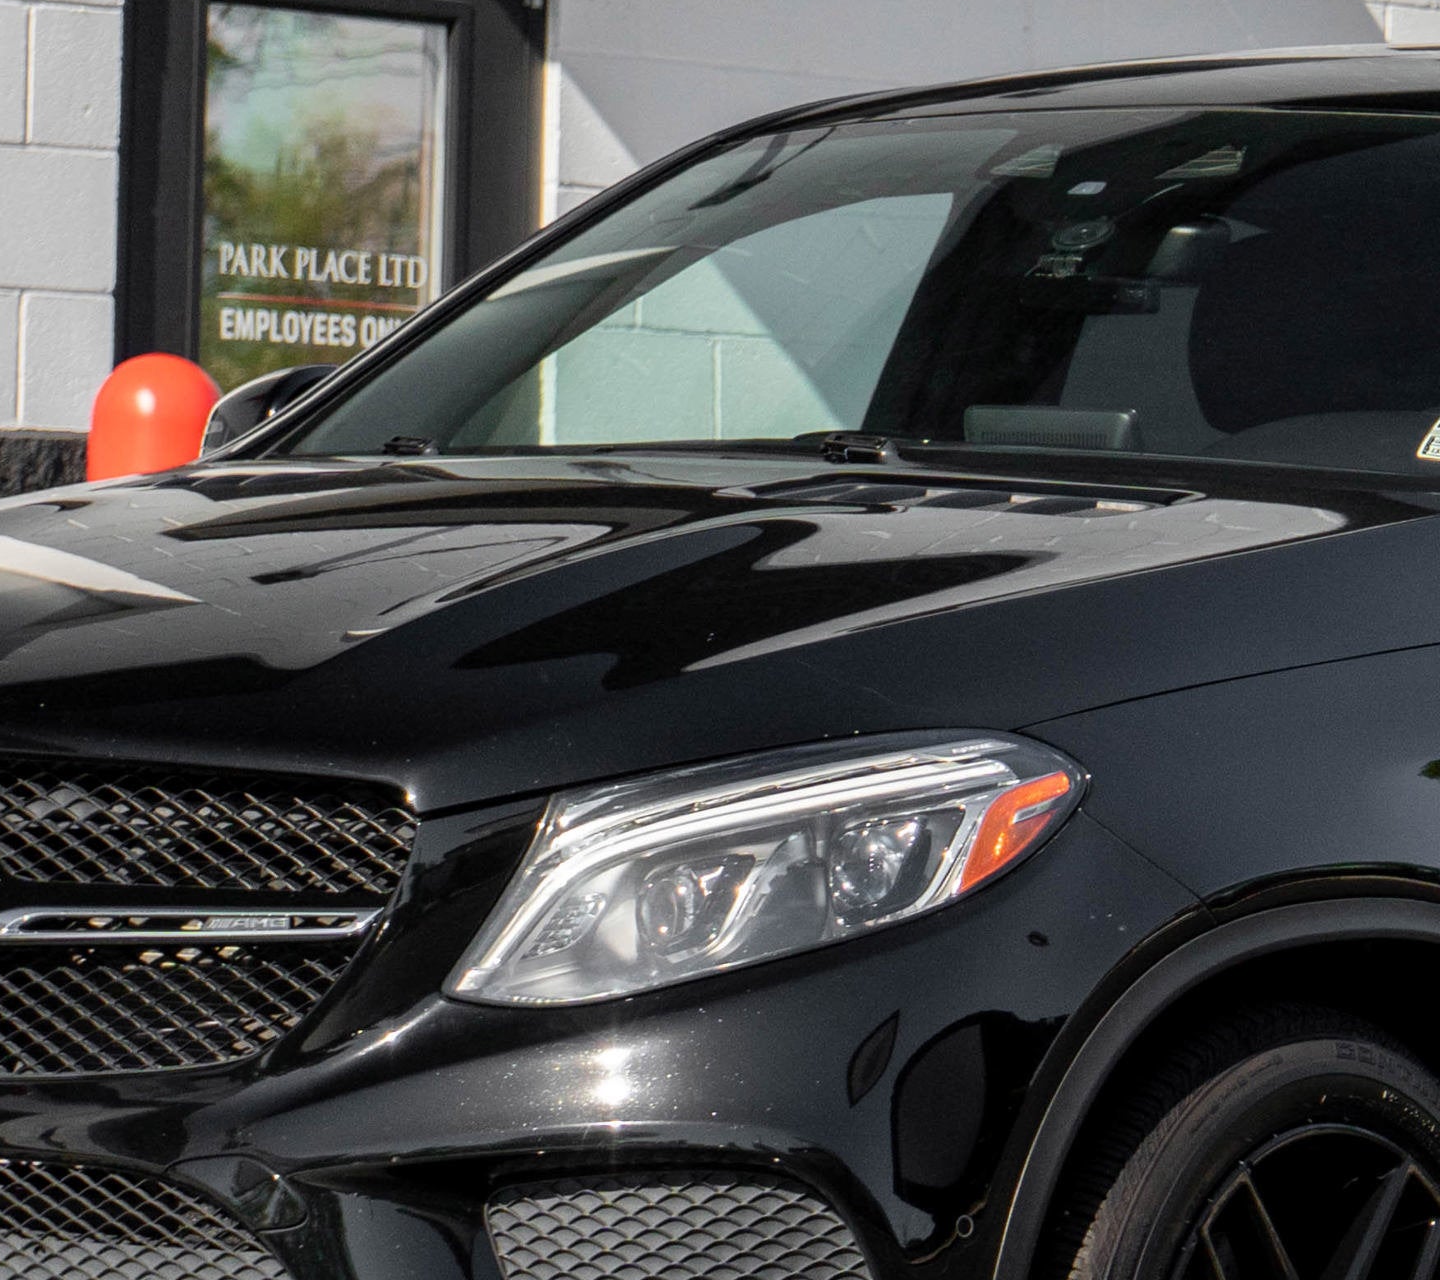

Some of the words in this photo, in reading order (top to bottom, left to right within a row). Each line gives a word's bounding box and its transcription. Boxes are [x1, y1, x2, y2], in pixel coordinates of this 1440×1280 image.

[219, 241, 289, 279] PARK
[294, 247, 372, 286] PLACE
[378, 253, 428, 289] LTD
[219, 306, 357, 347] EMPLOYEES
[230, 917, 287, 929] AMG
